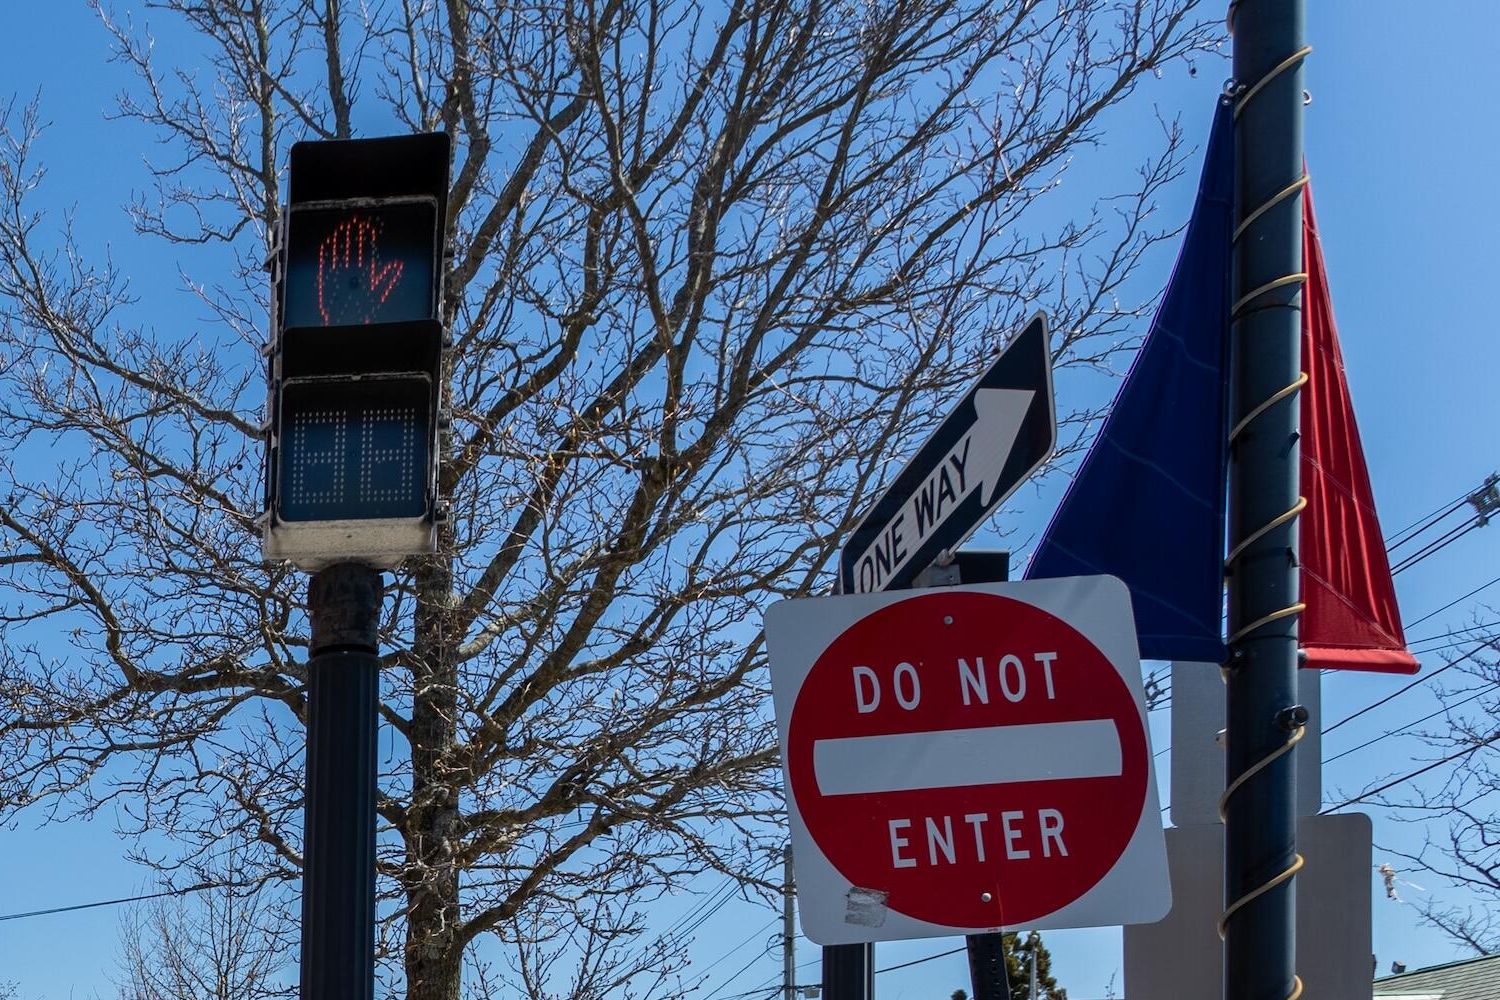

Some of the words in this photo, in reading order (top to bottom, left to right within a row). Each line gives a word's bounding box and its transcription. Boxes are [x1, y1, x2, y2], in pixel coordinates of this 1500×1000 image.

[860, 513, 908, 594] ONE
[914, 436, 971, 540] WAY
[852, 660, 922, 715] DO
[958, 652, 1058, 707] NOT
[888, 808, 1070, 870] ENTER
